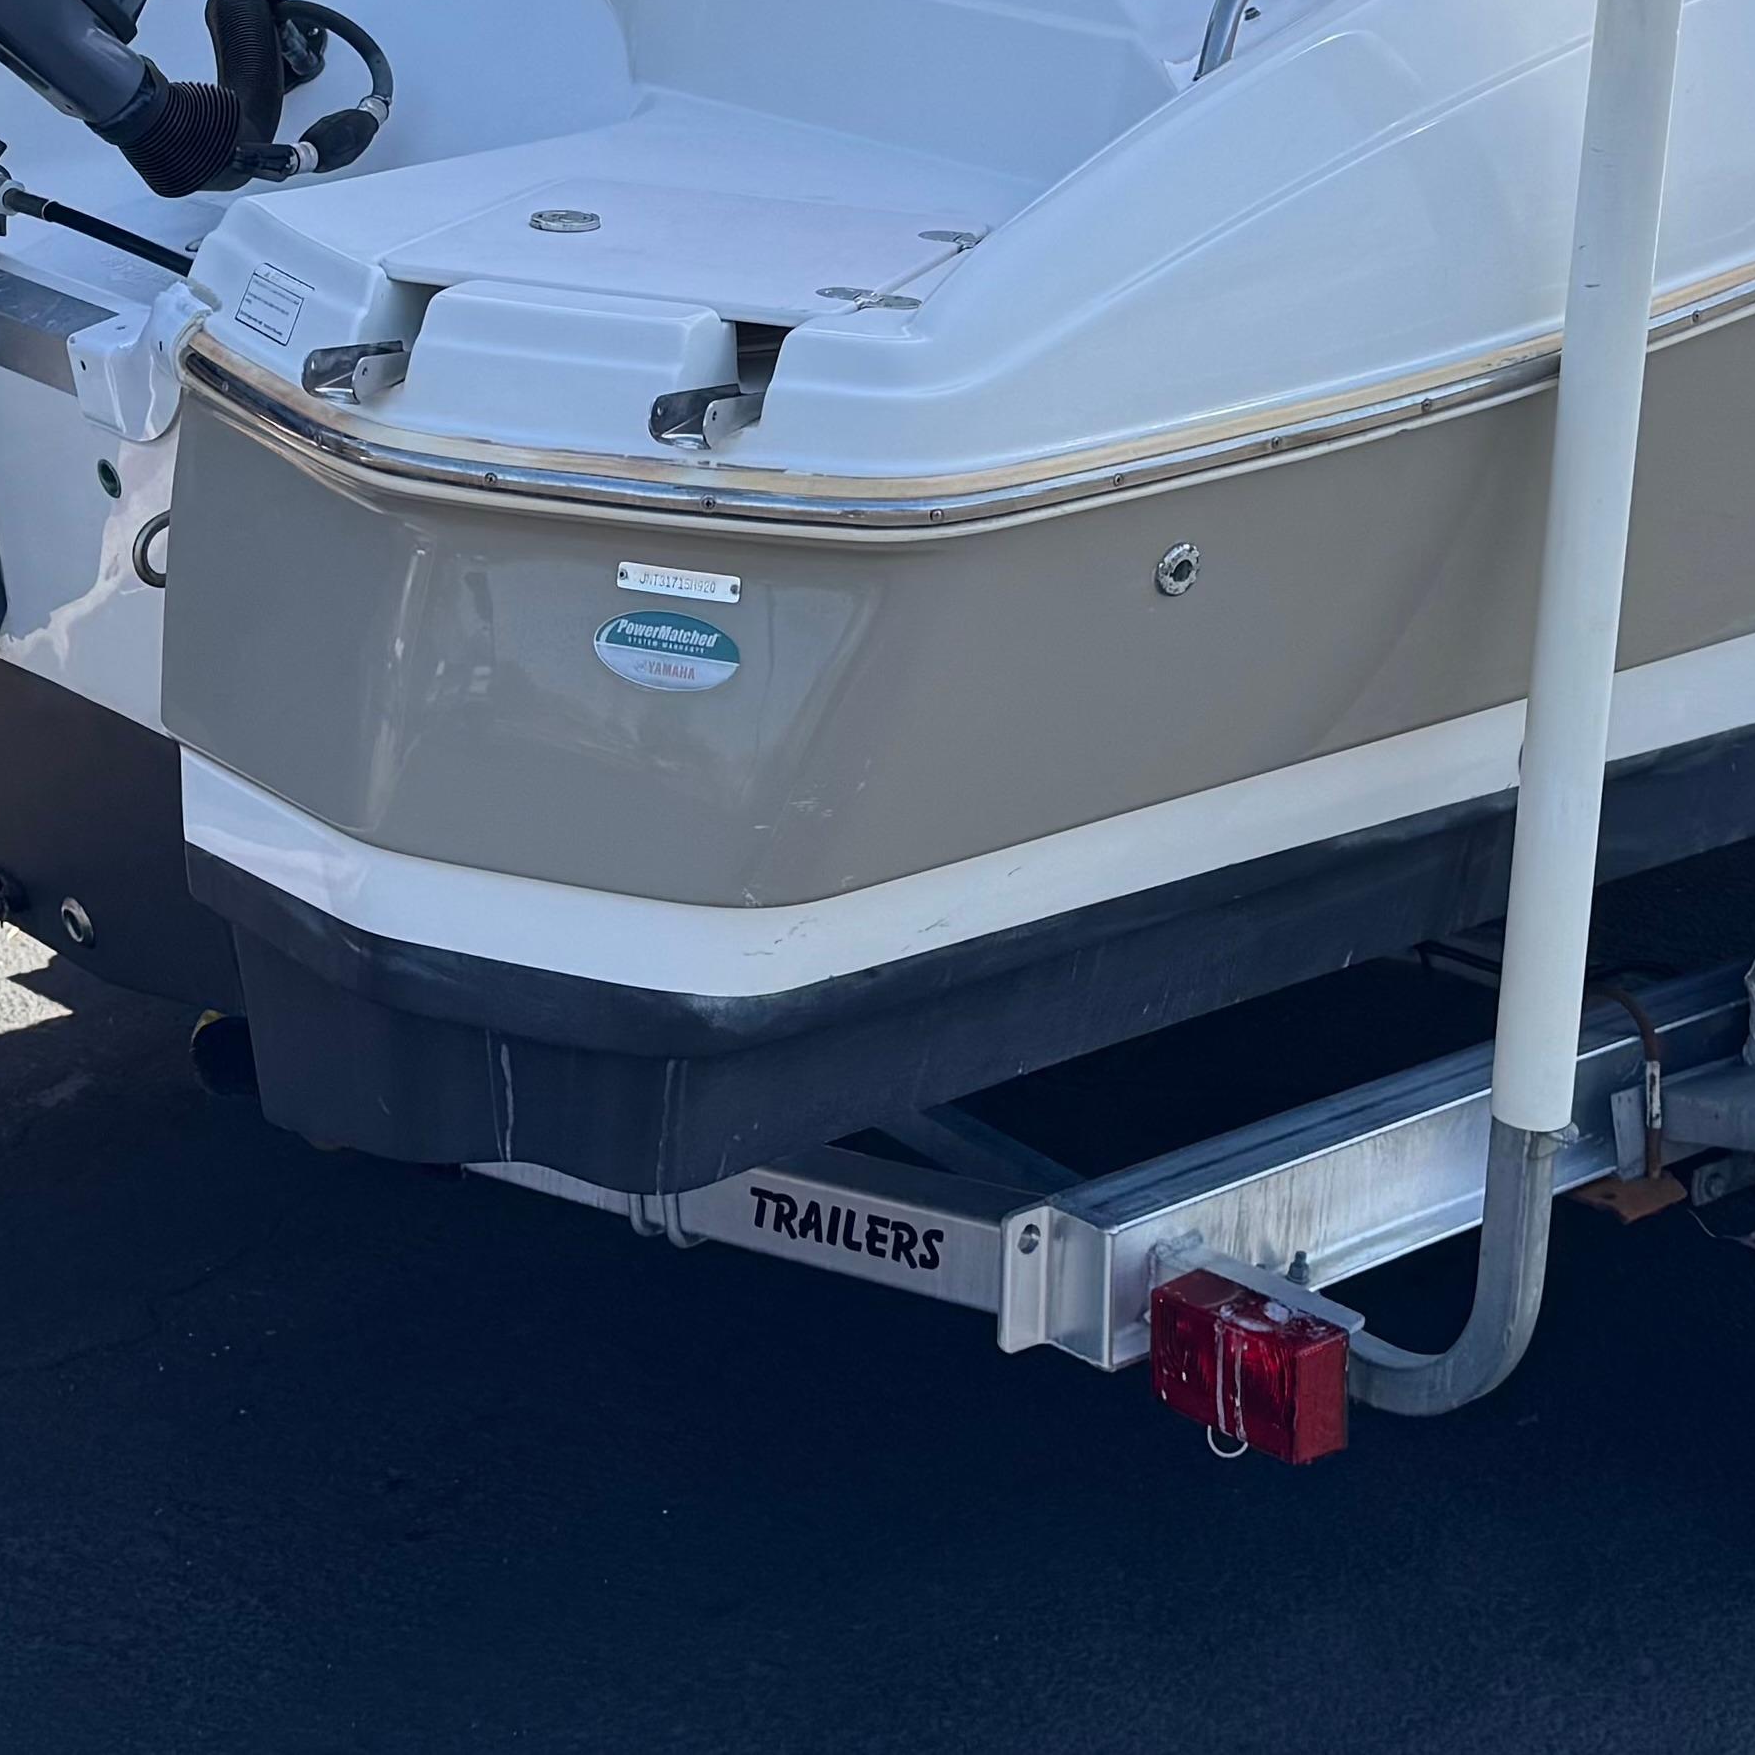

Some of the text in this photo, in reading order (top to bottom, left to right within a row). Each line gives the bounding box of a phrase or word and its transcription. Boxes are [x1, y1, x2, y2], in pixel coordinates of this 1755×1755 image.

[617, 619, 719, 648] PowerMatched
[647, 660, 696, 681] YAMAHA
[750, 1186, 945, 1271] TRAILERS
